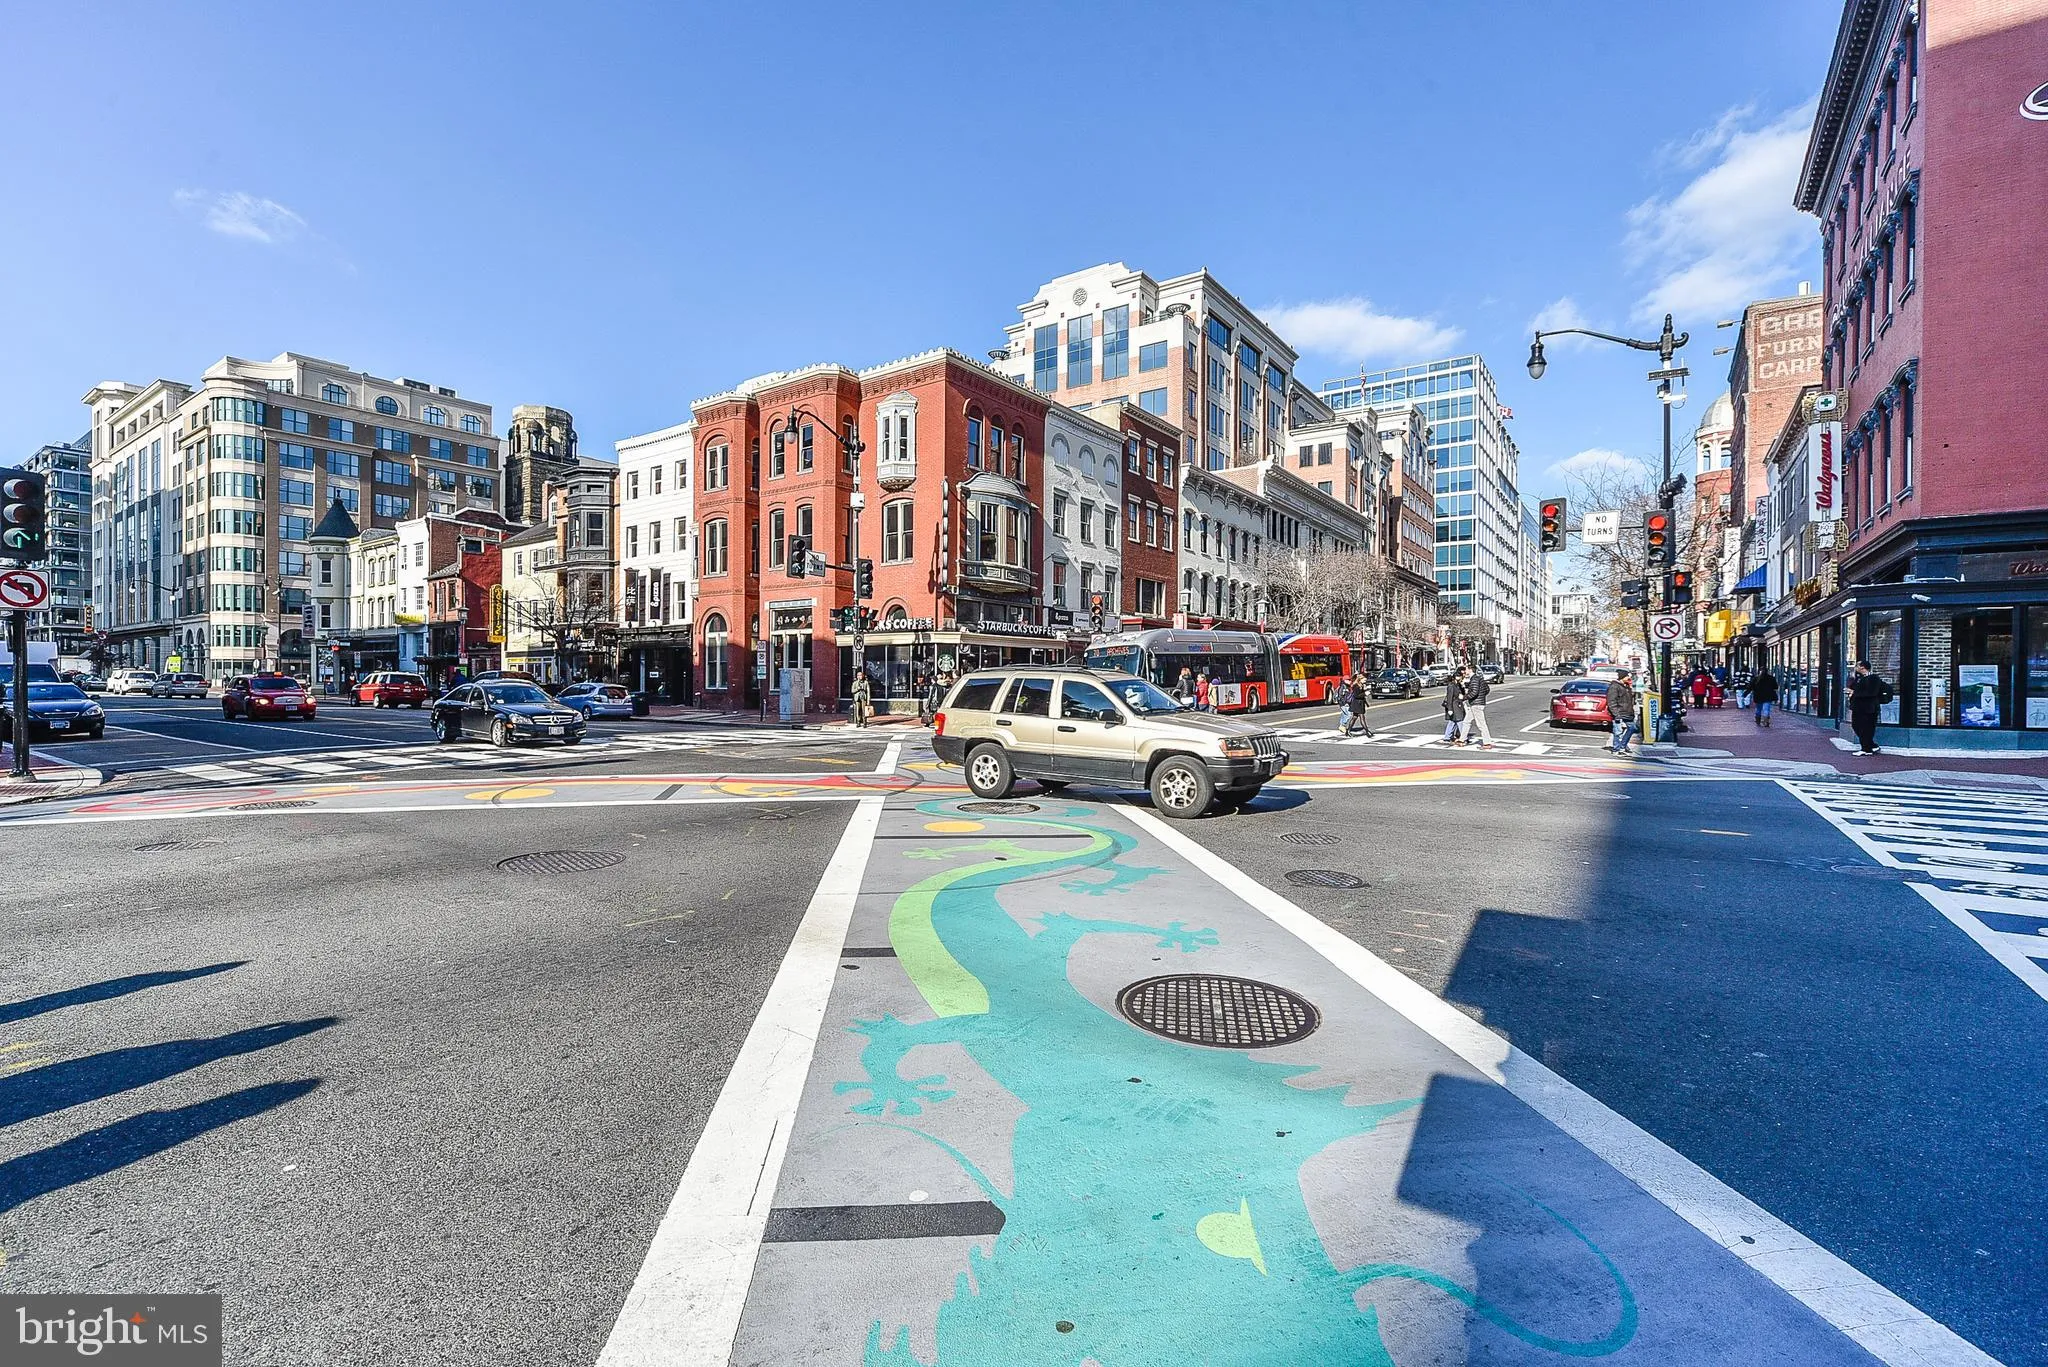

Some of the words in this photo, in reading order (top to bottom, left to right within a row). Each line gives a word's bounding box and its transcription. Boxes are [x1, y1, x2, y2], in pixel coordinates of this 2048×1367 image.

[1816, 430, 1838, 511] Walgreens
[1595, 515, 1607, 523] NO
[1587, 527, 1613, 536] TURNS
[893, 617, 933, 630] COFFEE
[978, 620, 1028, 634] STARBUCKS
[1028, 624, 1056, 637] COFFEE
